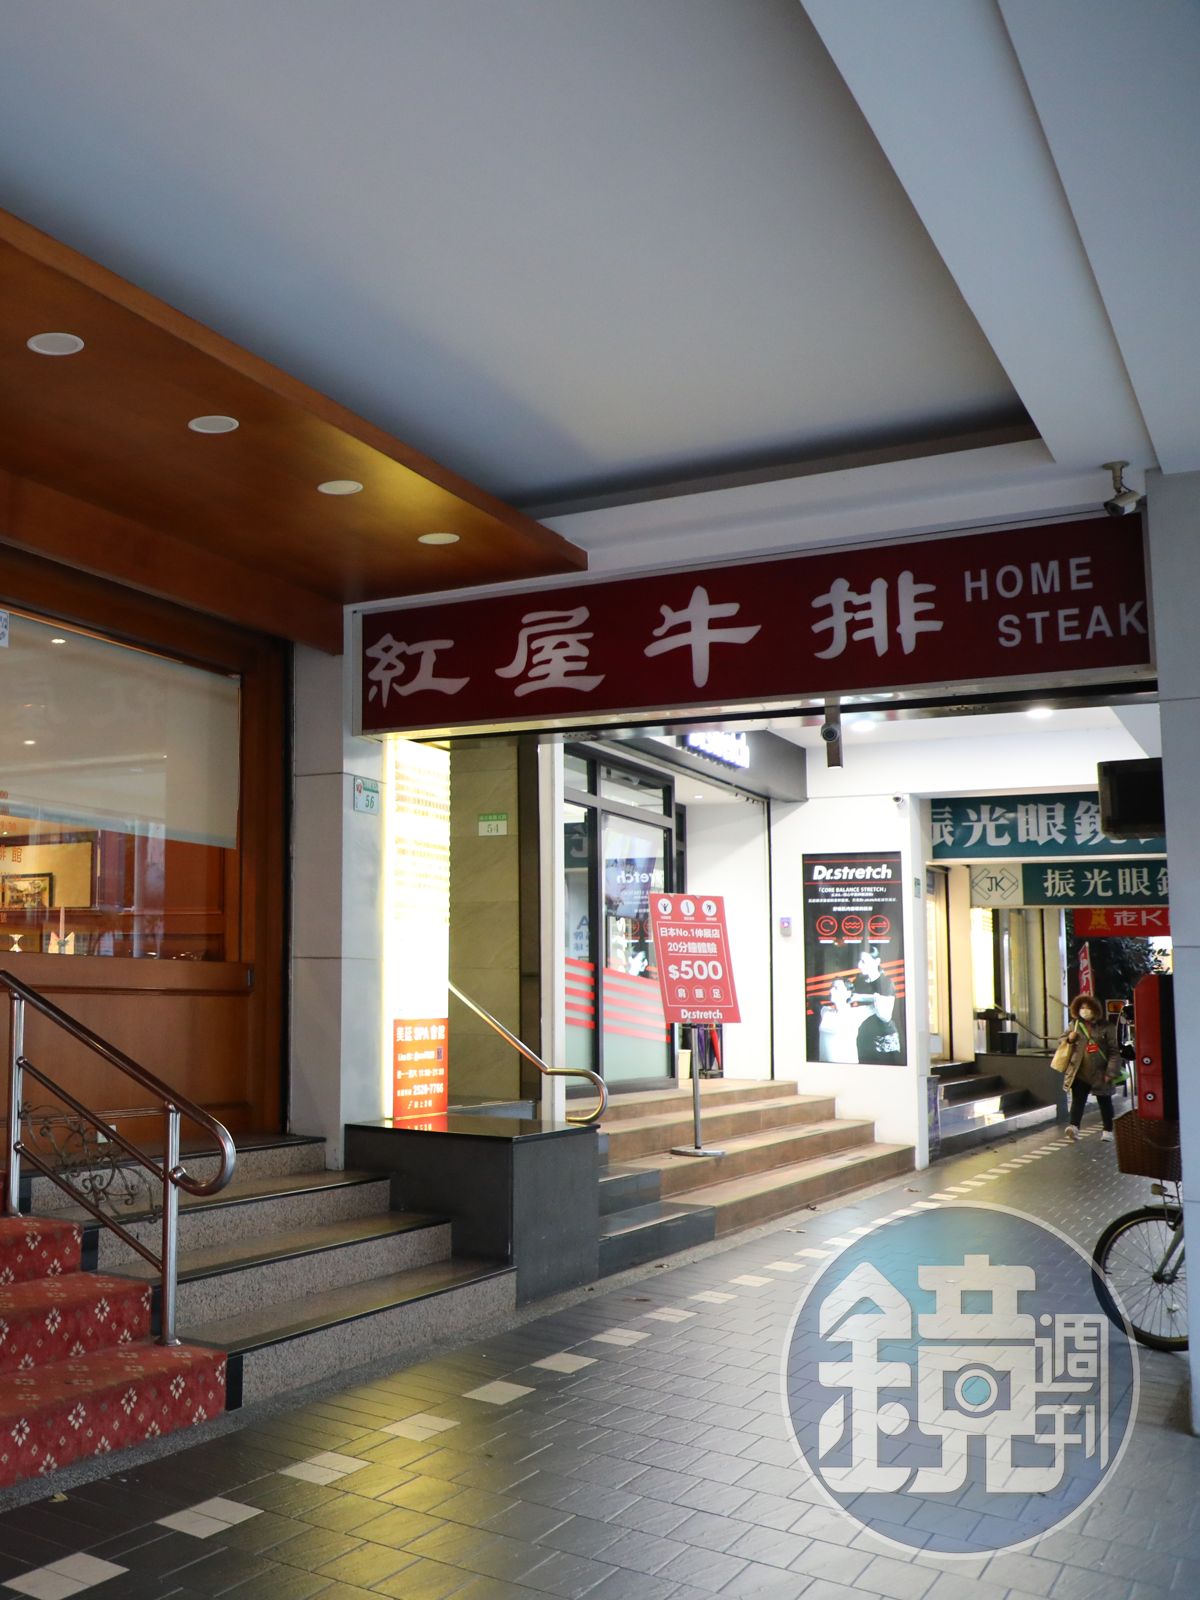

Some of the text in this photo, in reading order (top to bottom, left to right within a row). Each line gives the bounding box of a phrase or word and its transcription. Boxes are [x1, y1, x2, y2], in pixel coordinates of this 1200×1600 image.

[964, 556, 1094, 602] HOME
[998, 601, 1147, 648] STEAK
[366, 570, 944, 708] 紅屋牛排
[365, 794, 374, 809] 56
[813, 864, 892, 880] Dr.stretch
[986, 876, 1005, 893] JK
[668, 960, 723, 981] $500
[681, 1008, 723, 1019] Dr.stretch
